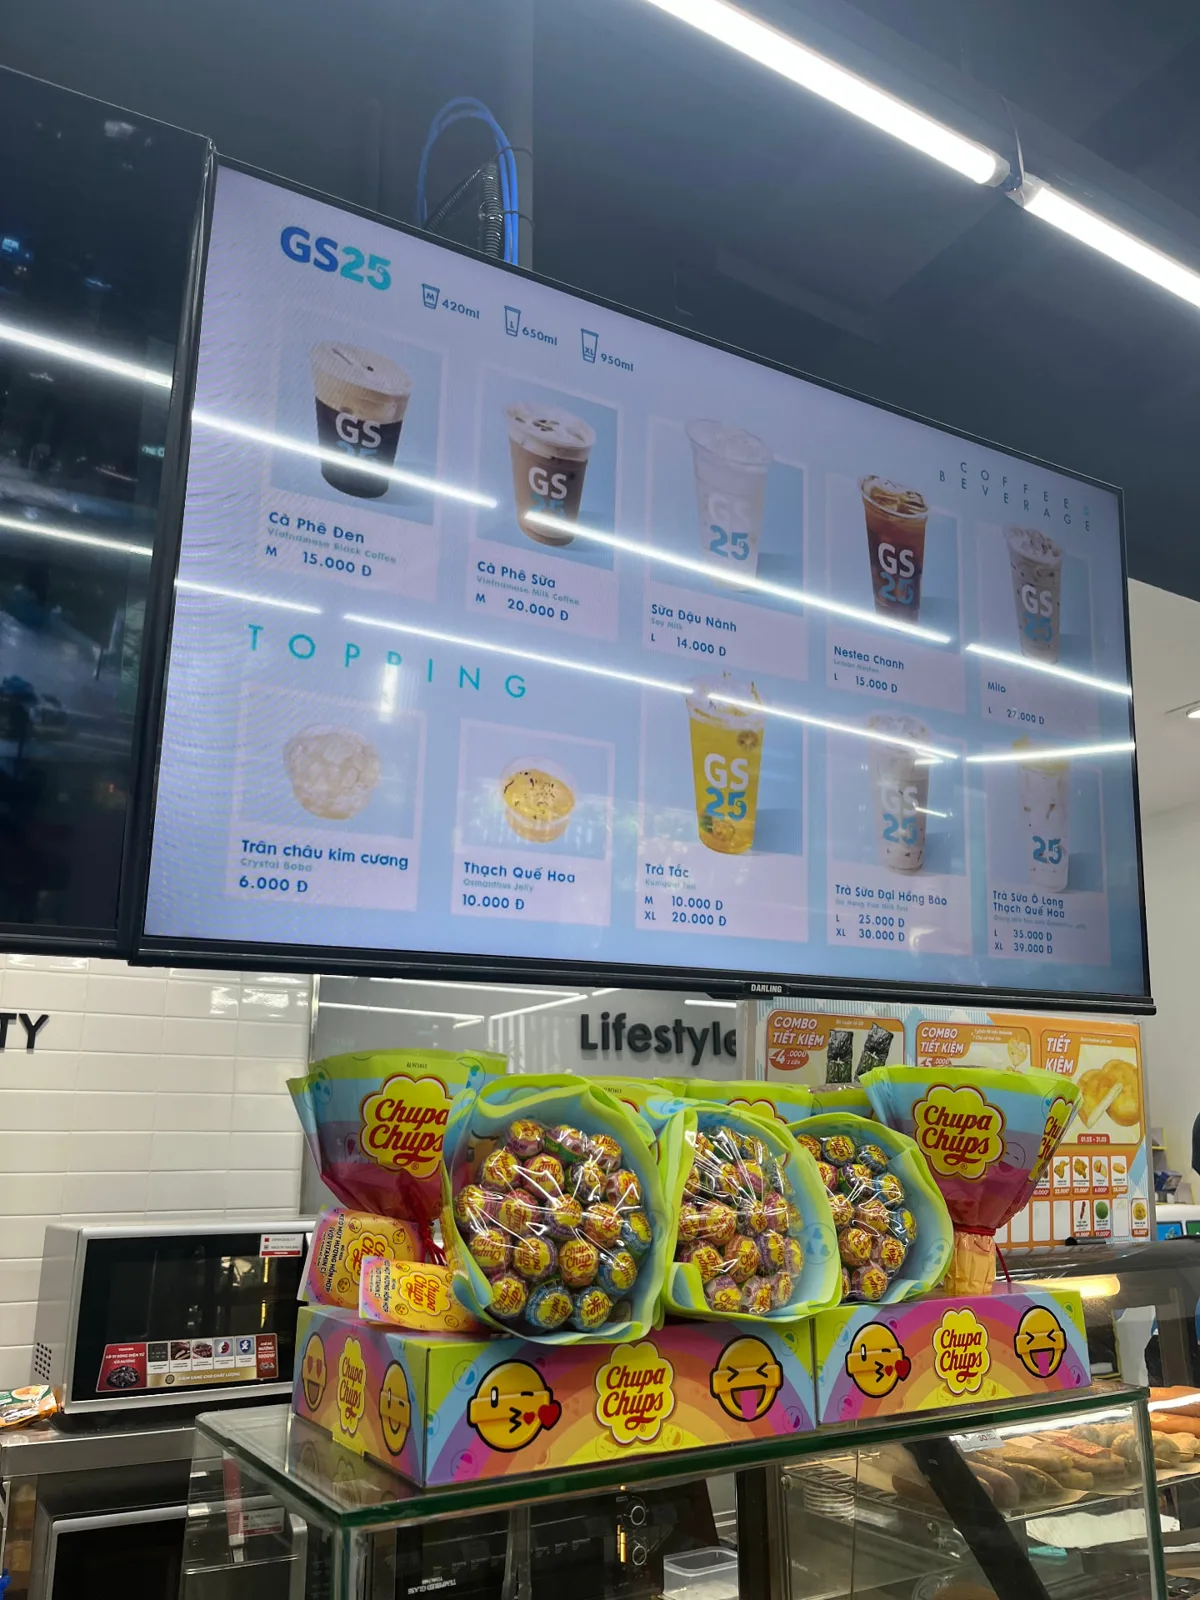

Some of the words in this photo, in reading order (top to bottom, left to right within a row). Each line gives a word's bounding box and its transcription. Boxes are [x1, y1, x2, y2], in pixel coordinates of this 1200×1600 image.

[280, 226, 392, 290] GS25
[442, 299, 480, 319] 420ml
[522, 327, 557, 346] 650ml
[601, 353, 634, 372] 950ml
[335, 411, 382, 448] GS
[528, 466, 568, 500] GS
[269, 511, 289, 527] Cà
[297, 517, 327, 536] Phê
[709, 524, 750, 561] 25
[265, 546, 277, 557] M
[303, 551, 355, 573] 15.000
[477, 560, 495, 574] Cà
[501, 565, 526, 582] Phê
[877, 543, 915, 578] GS
[879, 572, 914, 605] 25
[475, 593, 486, 603] M
[508, 598, 554, 618] 20.000
[1021, 584, 1053, 617] GS
[678, 609, 701, 624] Đậu
[706, 615, 737, 632] Nành
[651, 633, 656, 642] L
[677, 636, 715, 654] 14.000
[248, 624, 527, 698] TOPPING
[834, 646, 870, 662] Nestea
[873, 655, 904, 670] Chanh
[834, 673, 839, 681] L
[855, 675, 888, 691] 15.000
[1007, 709, 1036, 724] 27.000
[704, 752, 749, 790] GS
[706, 787, 747, 821] 25
[883, 813, 918, 845] 25
[242, 839, 277, 856] Trân
[283, 844, 323, 859] châu
[328, 848, 355, 863] kim
[361, 852, 409, 871] cương
[1032, 835, 1062, 865] 25
[240, 857, 279, 870] Crystal
[464, 861, 507, 879] Thạch
[513, 866, 543, 881] Quế
[548, 871, 576, 883] Hoa
[645, 863, 664, 876] Trà
[669, 863, 689, 878] Tắc
[239, 875, 290, 892] 6.000
[835, 882, 851, 895] Trà
[462, 894, 510, 909] 10.000
[645, 896, 654, 905] M
[671, 895, 711, 910] 10.000
[993, 902, 1021, 914] Thạch
[1047, 908, 1065, 918] Hoa
[1042, 897, 1064, 909] Long
[644, 911, 656, 921] XL
[672, 911, 714, 926] 20.000
[836, 914, 840, 922] L
[859, 914, 894, 927] 25.000
[836, 928, 846, 937] XL
[859, 928, 894, 941] 30.000
[1013, 929, 1044, 941] 35.000
[995, 942, 1003, 951] XL
[1013, 942, 1044, 954] 39.000
[751, 984, 783, 993] DARLING
[774, 1016, 818, 1030] COMBO
[921, 1026, 958, 1039] COMBO
[773, 1029, 796, 1045] TIẾT
[797, 1032, 825, 1049] KIỆM
[920, 1038, 940, 1053] TIẾT
[941, 1041, 964, 1056] KIỆM
[1046, 1033, 1072, 1053] TIẾT
[375, 1099, 450, 1130] Chupa
[923, 1105, 993, 1134] Chupa
[369, 1124, 444, 1165] Chups
[922, 1127, 990, 1166] Chups
[566, 1252, 594, 1271] Chups
[406, 1275, 427, 1307] Chups
[424, 1279, 440, 1312] Chupa
[940, 1329, 982, 1352] Chupa
[342, 1357, 363, 1387] Chupa
[940, 1350, 983, 1383] Chups
[606, 1366, 666, 1394] Chupa
[339, 1378, 361, 1420] Chups
[603, 1390, 664, 1430] Chups
[408, 1585, 427, 1594] GLASS
